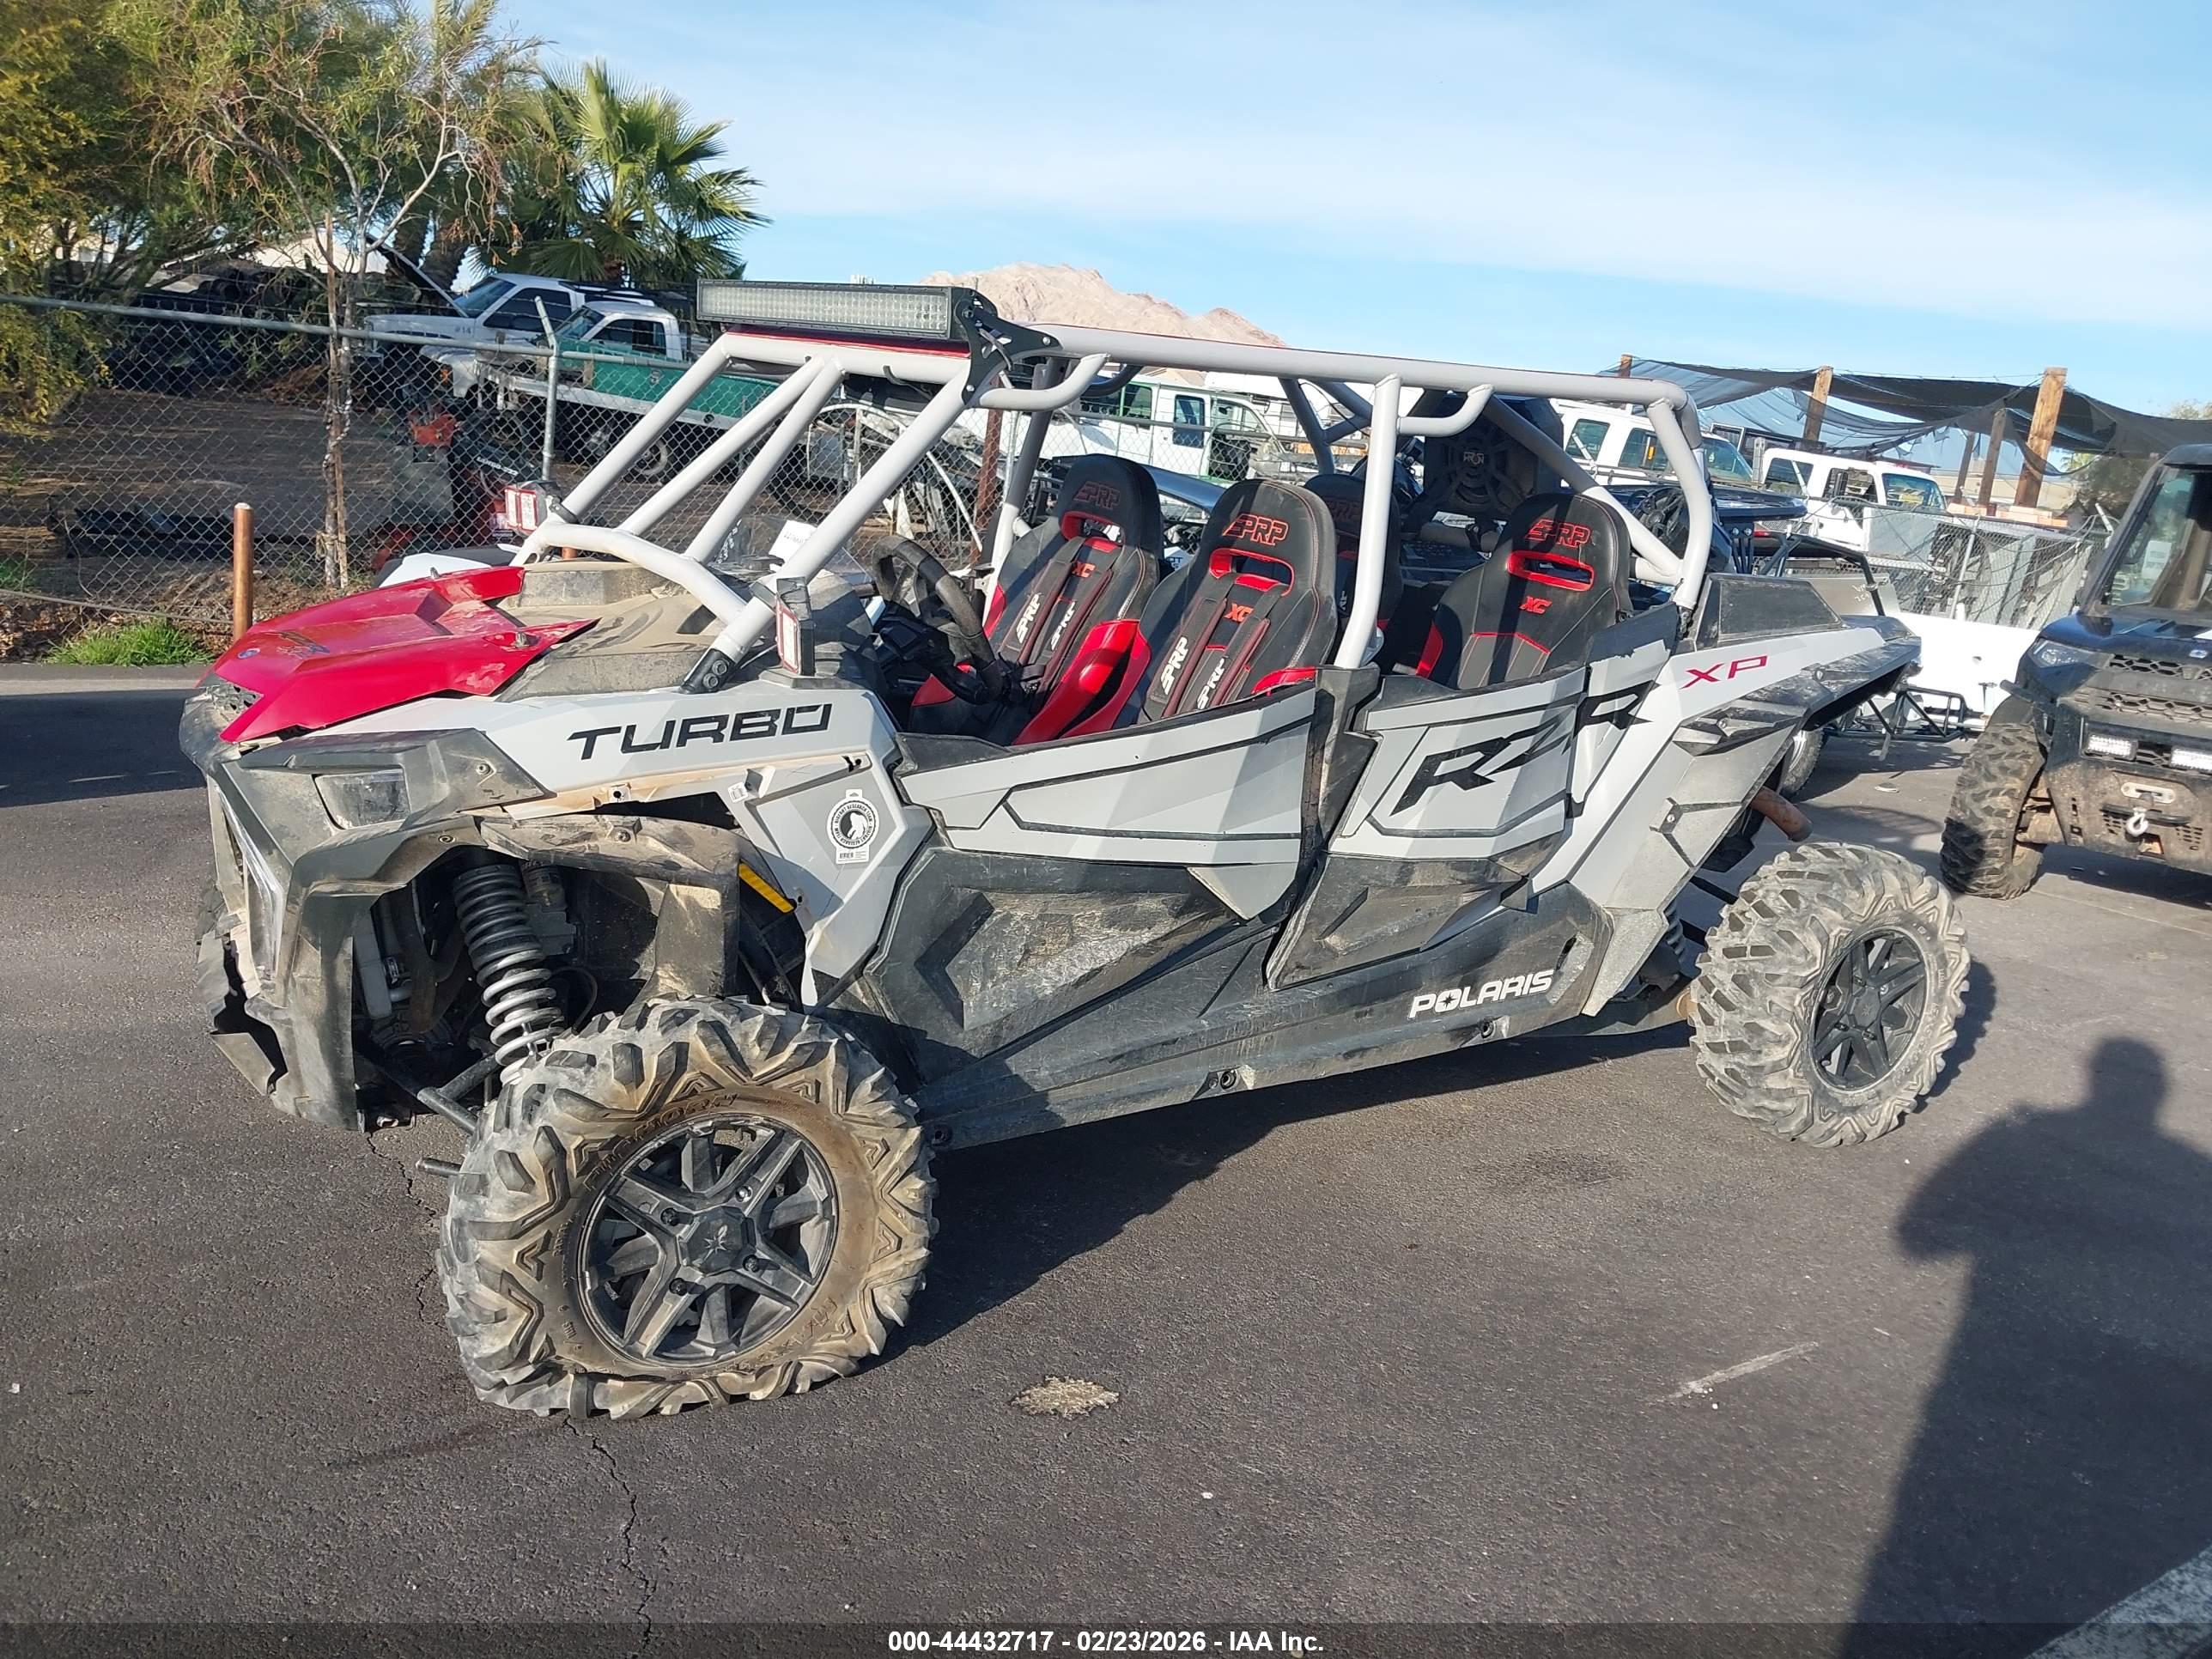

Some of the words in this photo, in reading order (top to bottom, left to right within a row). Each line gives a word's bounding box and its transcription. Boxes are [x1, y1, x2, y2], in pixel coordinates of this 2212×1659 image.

[1683, 654, 1767, 688] XP
[567, 703, 833, 761] TURBO
[1407, 969, 1555, 1020] POLARIS
